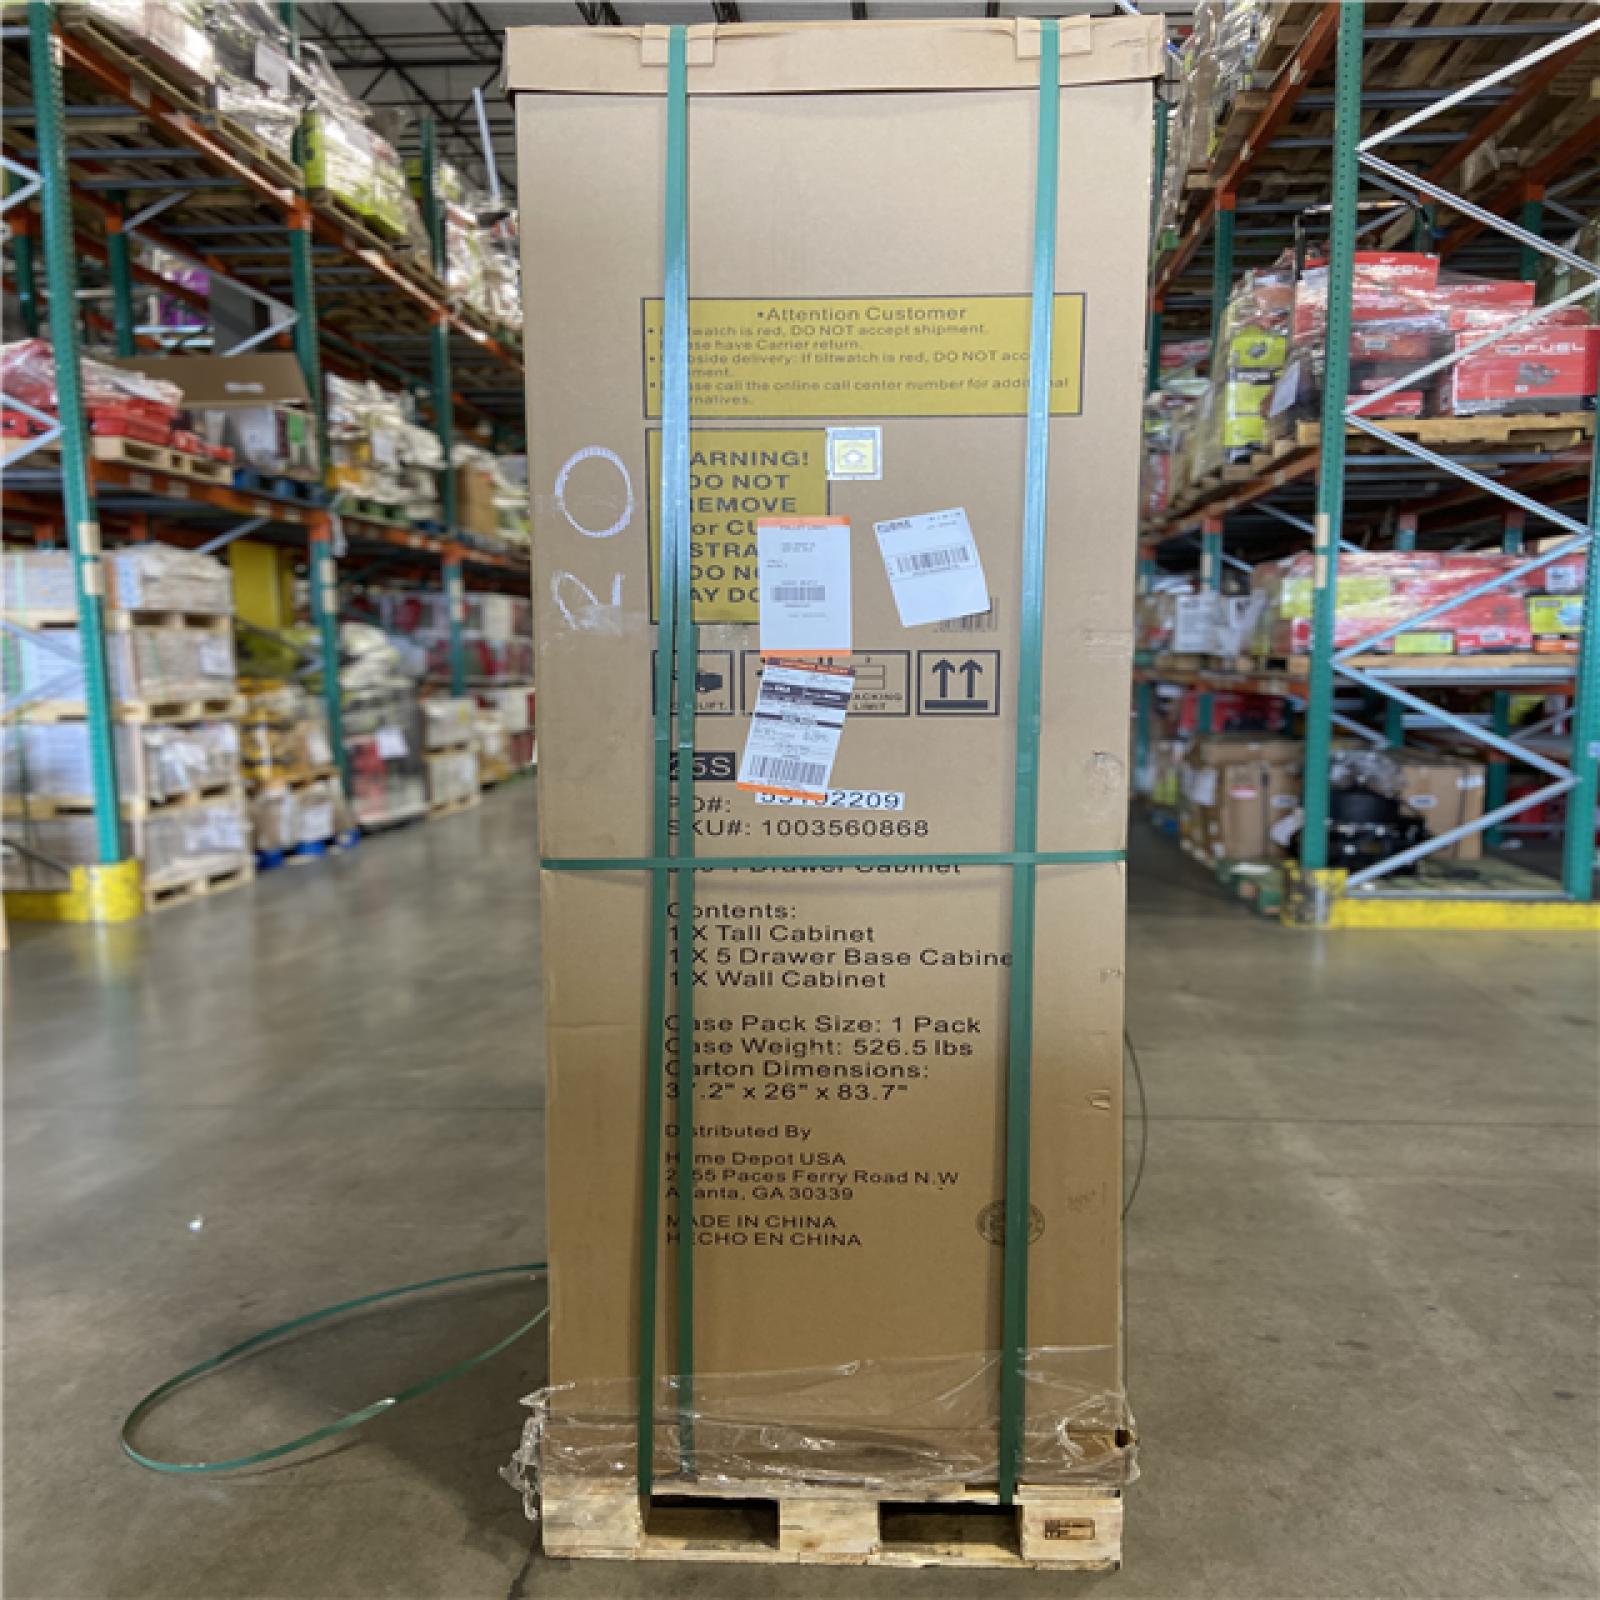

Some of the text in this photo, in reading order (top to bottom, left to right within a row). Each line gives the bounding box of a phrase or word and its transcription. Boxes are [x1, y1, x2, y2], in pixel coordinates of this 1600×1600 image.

[767, 306, 967, 321] Attention Customer
[687, 327, 736, 336] watch
[791, 325, 815, 335] DO
[820, 325, 854, 335] NOT
[859, 325, 909, 337] accept
[715, 340, 752, 350] have
[934, 351, 958, 362] DO
[963, 350, 997, 361] NOT
[746, 380, 769, 391] the
[906, 377, 963, 390] number
[967, 377, 988, 389] for
[690, 450, 809, 466] ARNING!
[690, 474, 791, 490] DO NOT
[690, 497, 797, 512] EMOVE
[726, 520, 759, 535] CU
[690, 542, 759, 557] STRA
[690, 587, 720, 602] AY
[762, 819, 929, 836] 1003560868
[667, 902, 796, 919] Contents:
[669, 924, 874, 942] 1 X Tall Cabinet
[669, 947, 1014, 966] 1 X 5 Drawer Base Cabine
[669, 970, 886, 988] 1 X Wall Cabinet
[742, 1014, 806, 1032] Pack
[815, 1014, 880, 1033] Size:
[892, 1016, 901, 1032] 1
[914, 1016, 981, 1033] Pack
[741, 1037, 841, 1058] Weight:
[853, 1039, 927, 1056] 526.5
[934, 1039, 974, 1056] lbs
[764, 1060, 929, 1078] Dimensions:
[666, 1082, 908, 1100] 3.2" x 26" x 83.7"
[665, 1124, 811, 1141] Dtributed By
[665, 1151, 846, 1168] Hme Depot USA
[665, 1168, 716, 1182] 255
[722, 1168, 787, 1182] Paces
[792, 1169, 848, 1186] Ferry
[854, 1169, 908, 1183] Road
[665, 1187, 853, 1200] Aanta, GA 30339
[666, 1214, 836, 1228] MDE IN CHINA
[666, 1231, 862, 1246] HCHO EN CHINA
